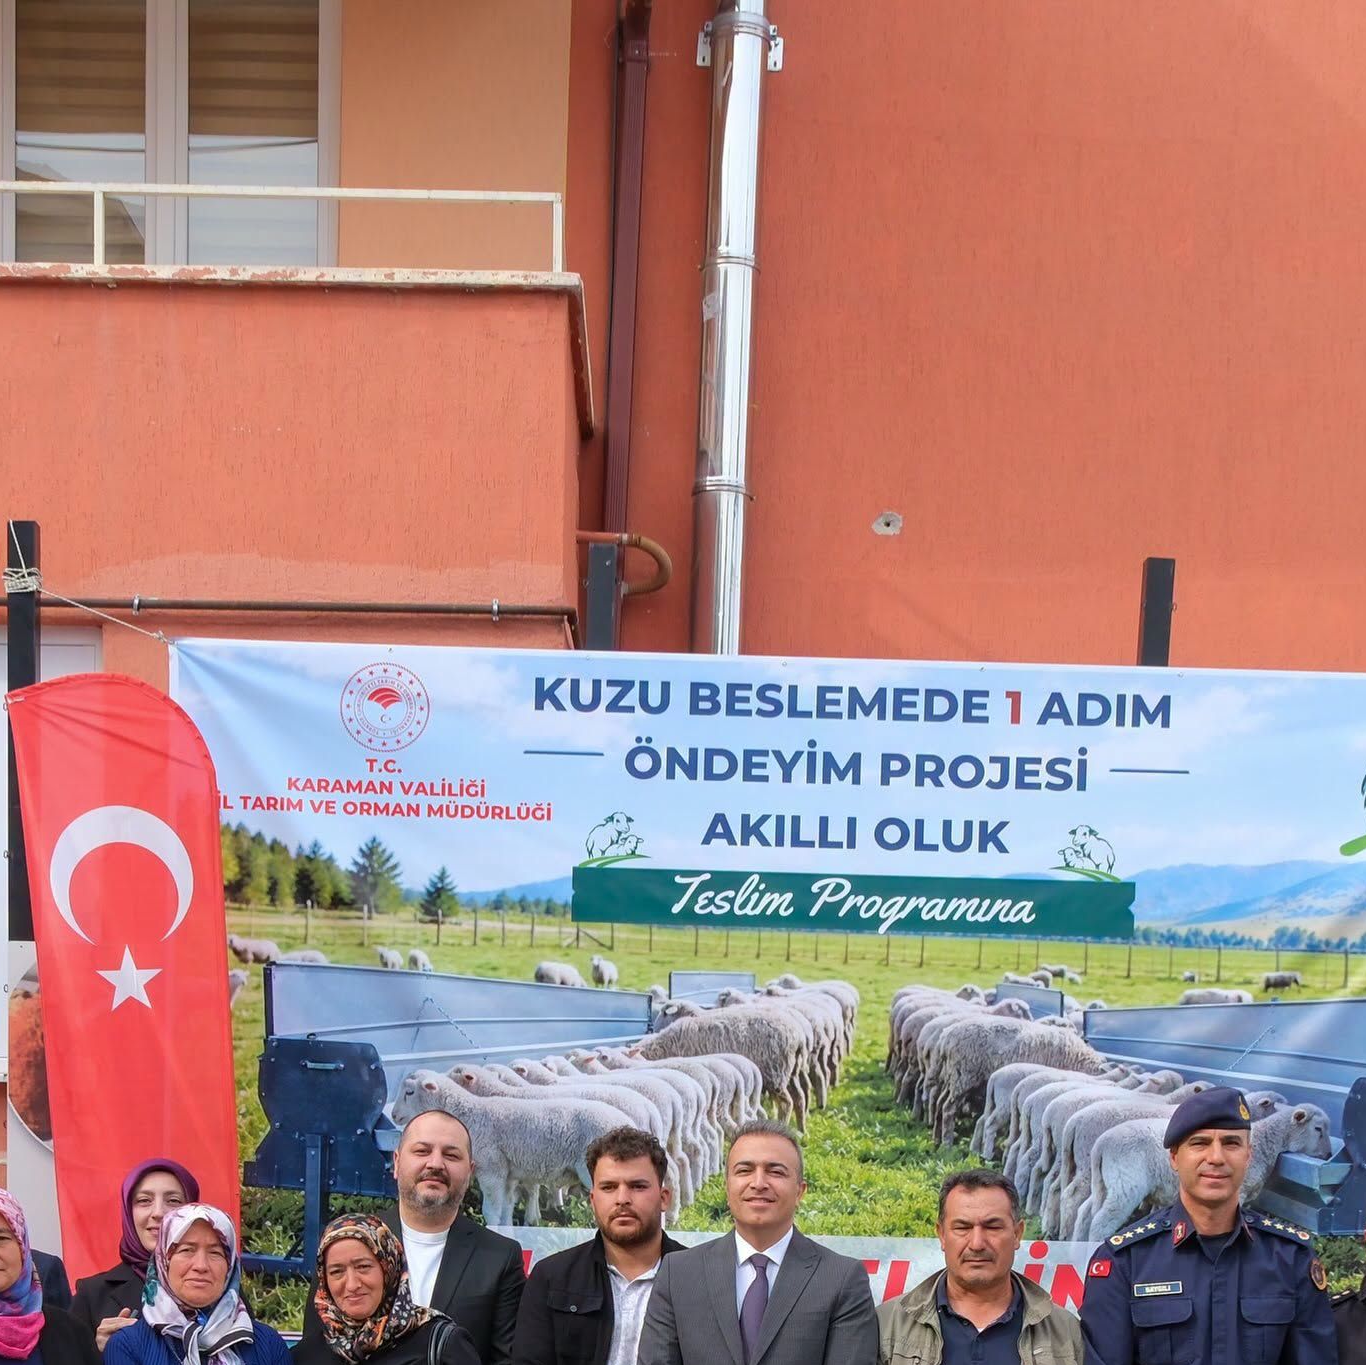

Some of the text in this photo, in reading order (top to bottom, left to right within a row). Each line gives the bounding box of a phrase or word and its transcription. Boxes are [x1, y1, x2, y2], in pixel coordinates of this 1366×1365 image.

[533, 677, 1172, 729] KUZU BESLEMEDE 1 ADIM
[366, 758, 403, 774] T.C.
[624, 736, 1088, 792] ÖNDEYİM PROJESİ
[239, 795, 304, 812] TARIM
[309, 799, 336, 814] VE
[342, 801, 421, 817] ORMAN
[287, 777, 486, 798] KARAMAN VALİLİĞİ
[700, 812, 1010, 854] AKILLI OLUK
[672, 872, 795, 918] Teslim
